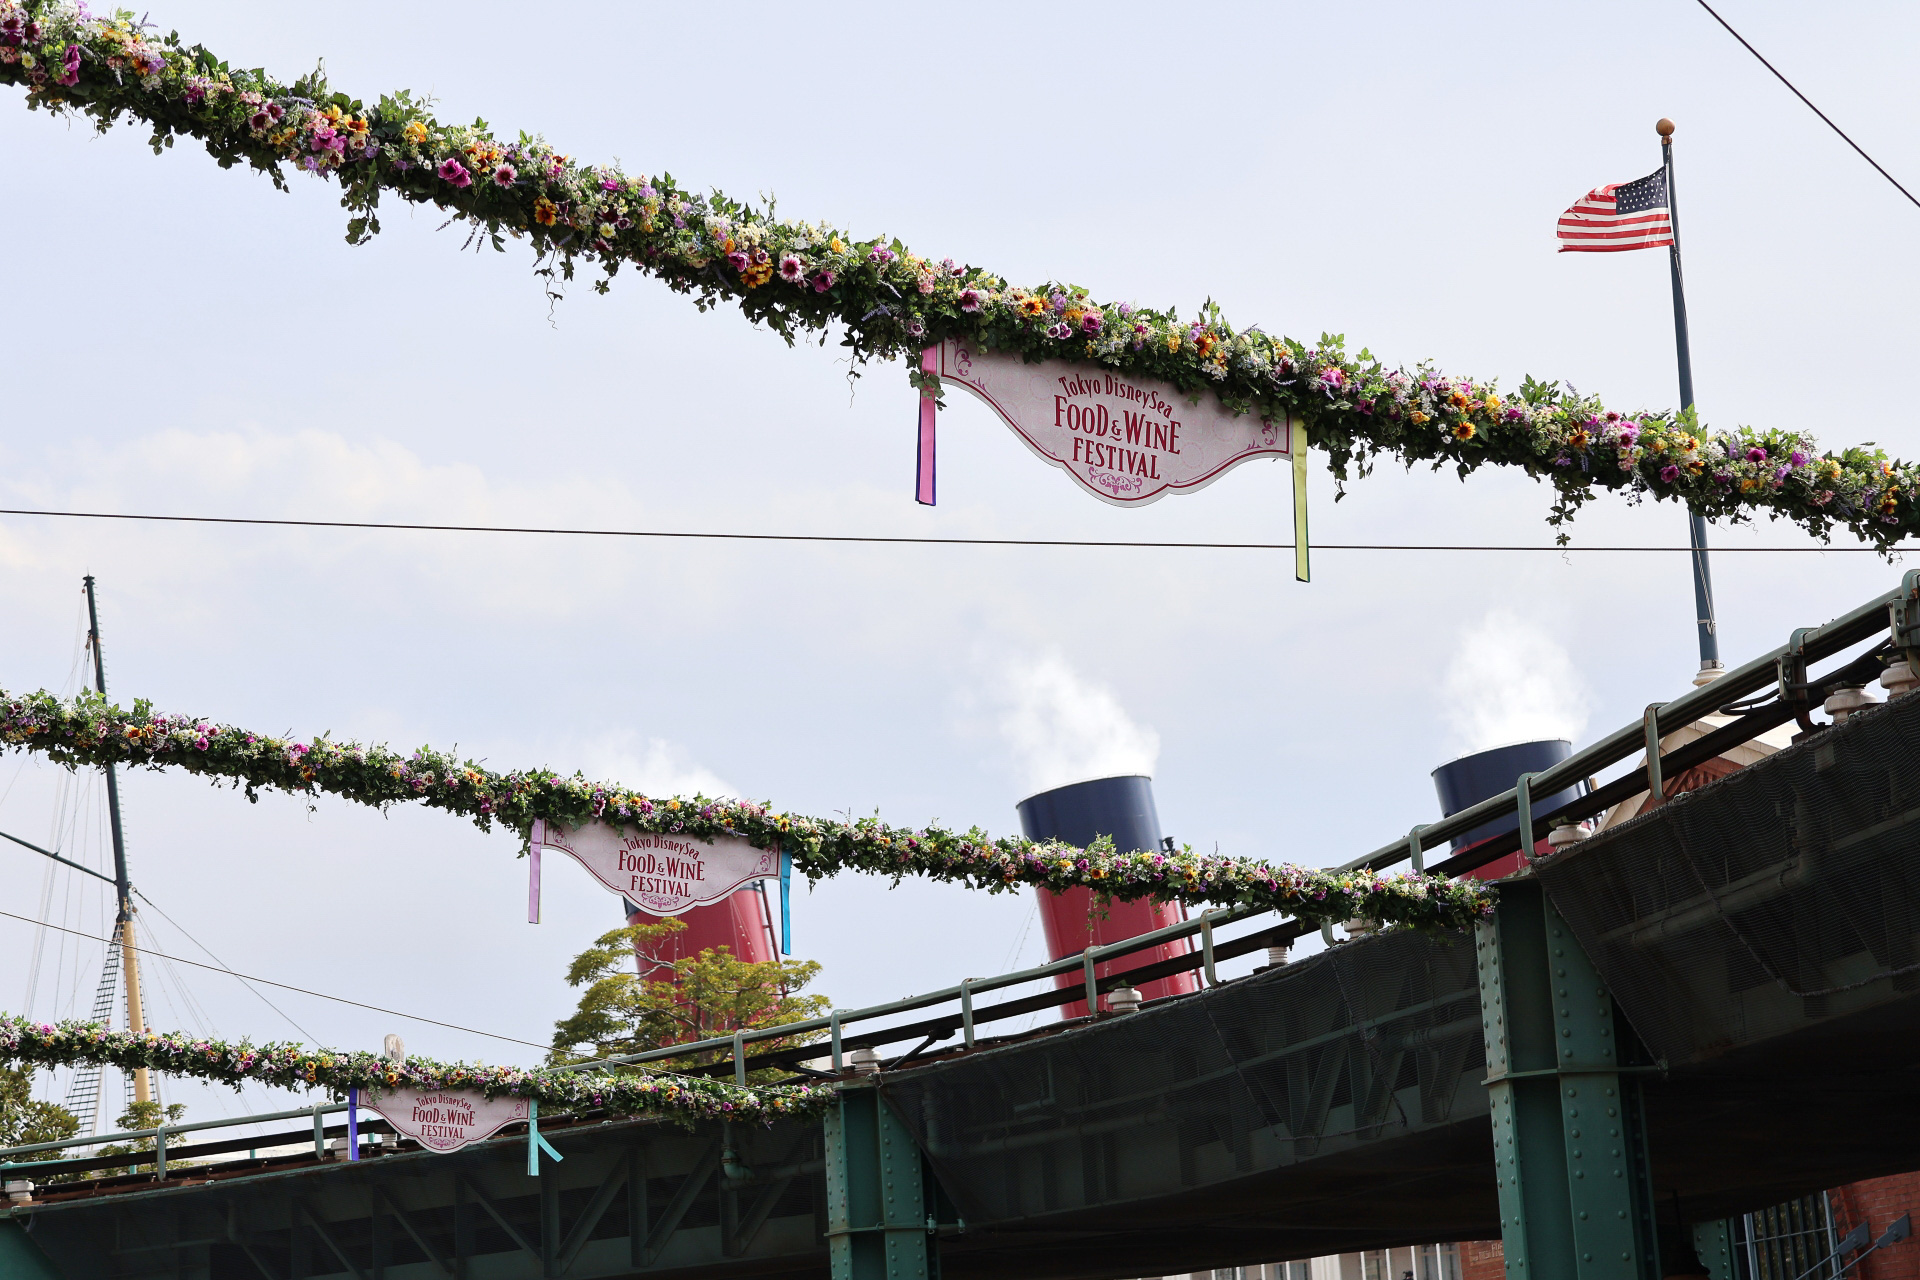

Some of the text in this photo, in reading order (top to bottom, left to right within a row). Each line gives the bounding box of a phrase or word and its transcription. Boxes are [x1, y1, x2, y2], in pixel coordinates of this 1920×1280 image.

[1058, 374, 1173, 419] Tokyo DisneySea
[1054, 394, 1181, 455] FOOD & WINE
[1072, 437, 1161, 480] FESTIVAL
[623, 835, 700, 860] Tokyo DisneySea
[618, 850, 705, 881] FOOD & WINE
[630, 875, 691, 898] FESTIVAL
[416, 1094, 472, 1111] Tokyo DisneySea
[412, 1106, 476, 1127] FOOD & WINE
[421, 1124, 465, 1139] FESTIVAL
